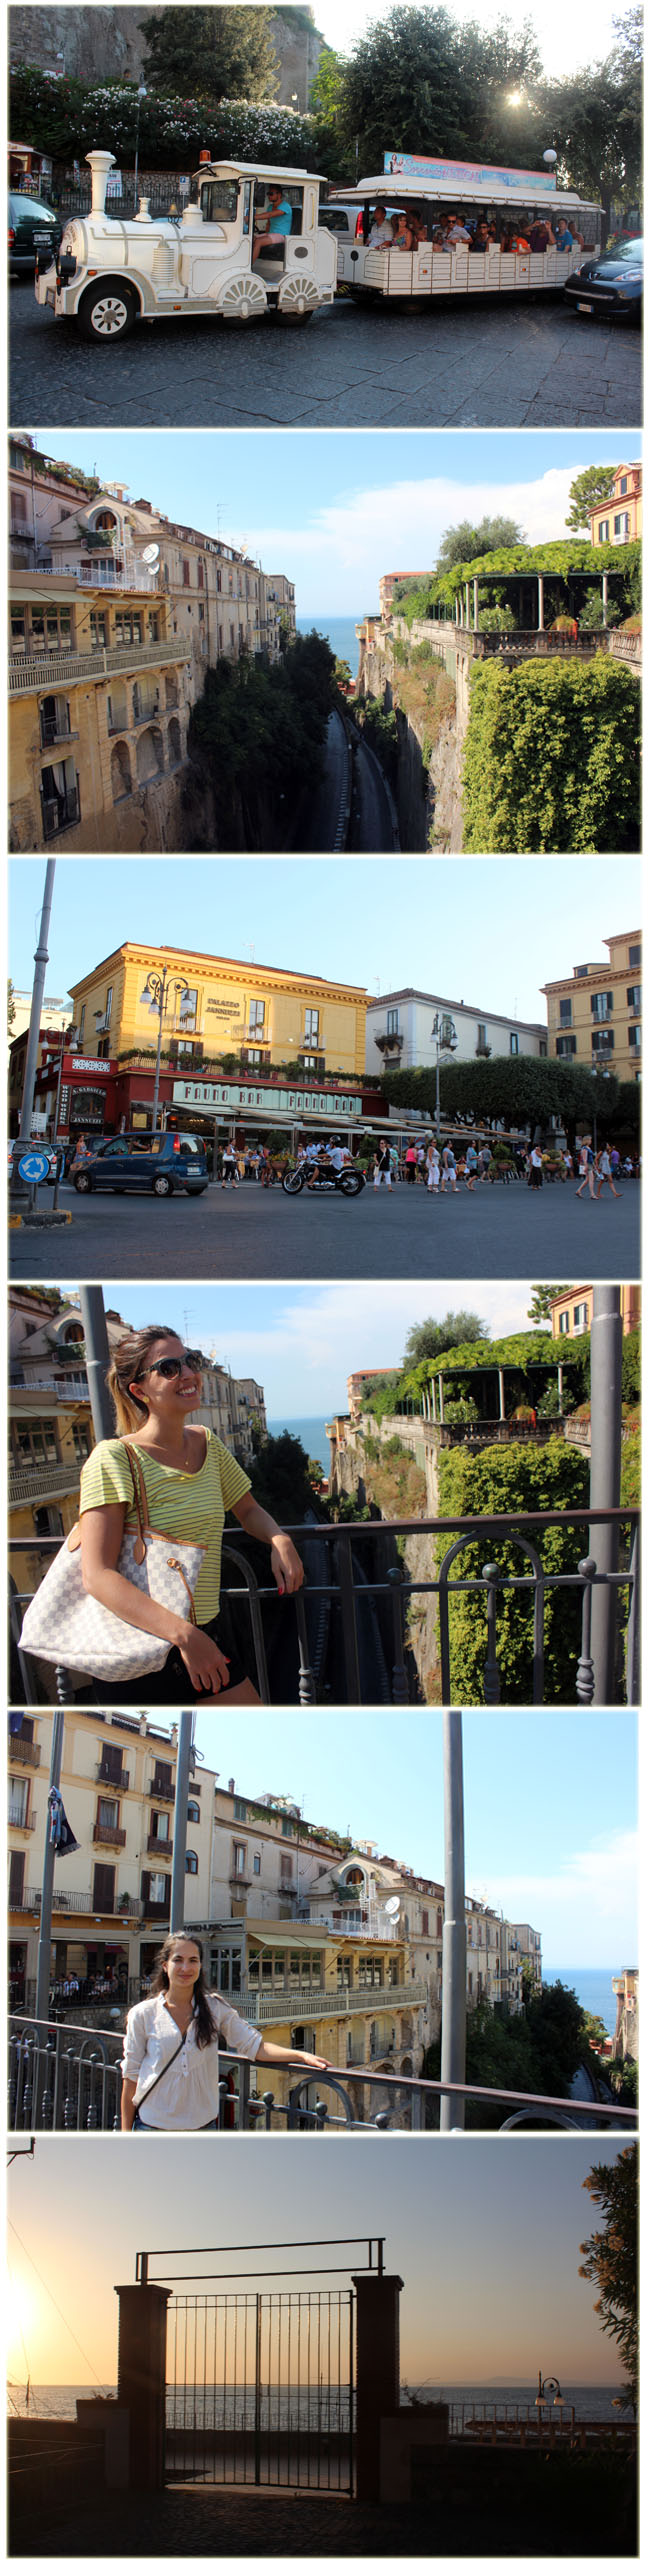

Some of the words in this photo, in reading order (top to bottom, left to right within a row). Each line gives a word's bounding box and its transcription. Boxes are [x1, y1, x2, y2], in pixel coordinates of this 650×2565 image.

[185, 1086, 229, 1102] FAUNO
[239, 1091, 264, 1105] BAR
[289, 1095, 327, 1110] FAUNO
[335, 1099, 356, 1112] BAR
